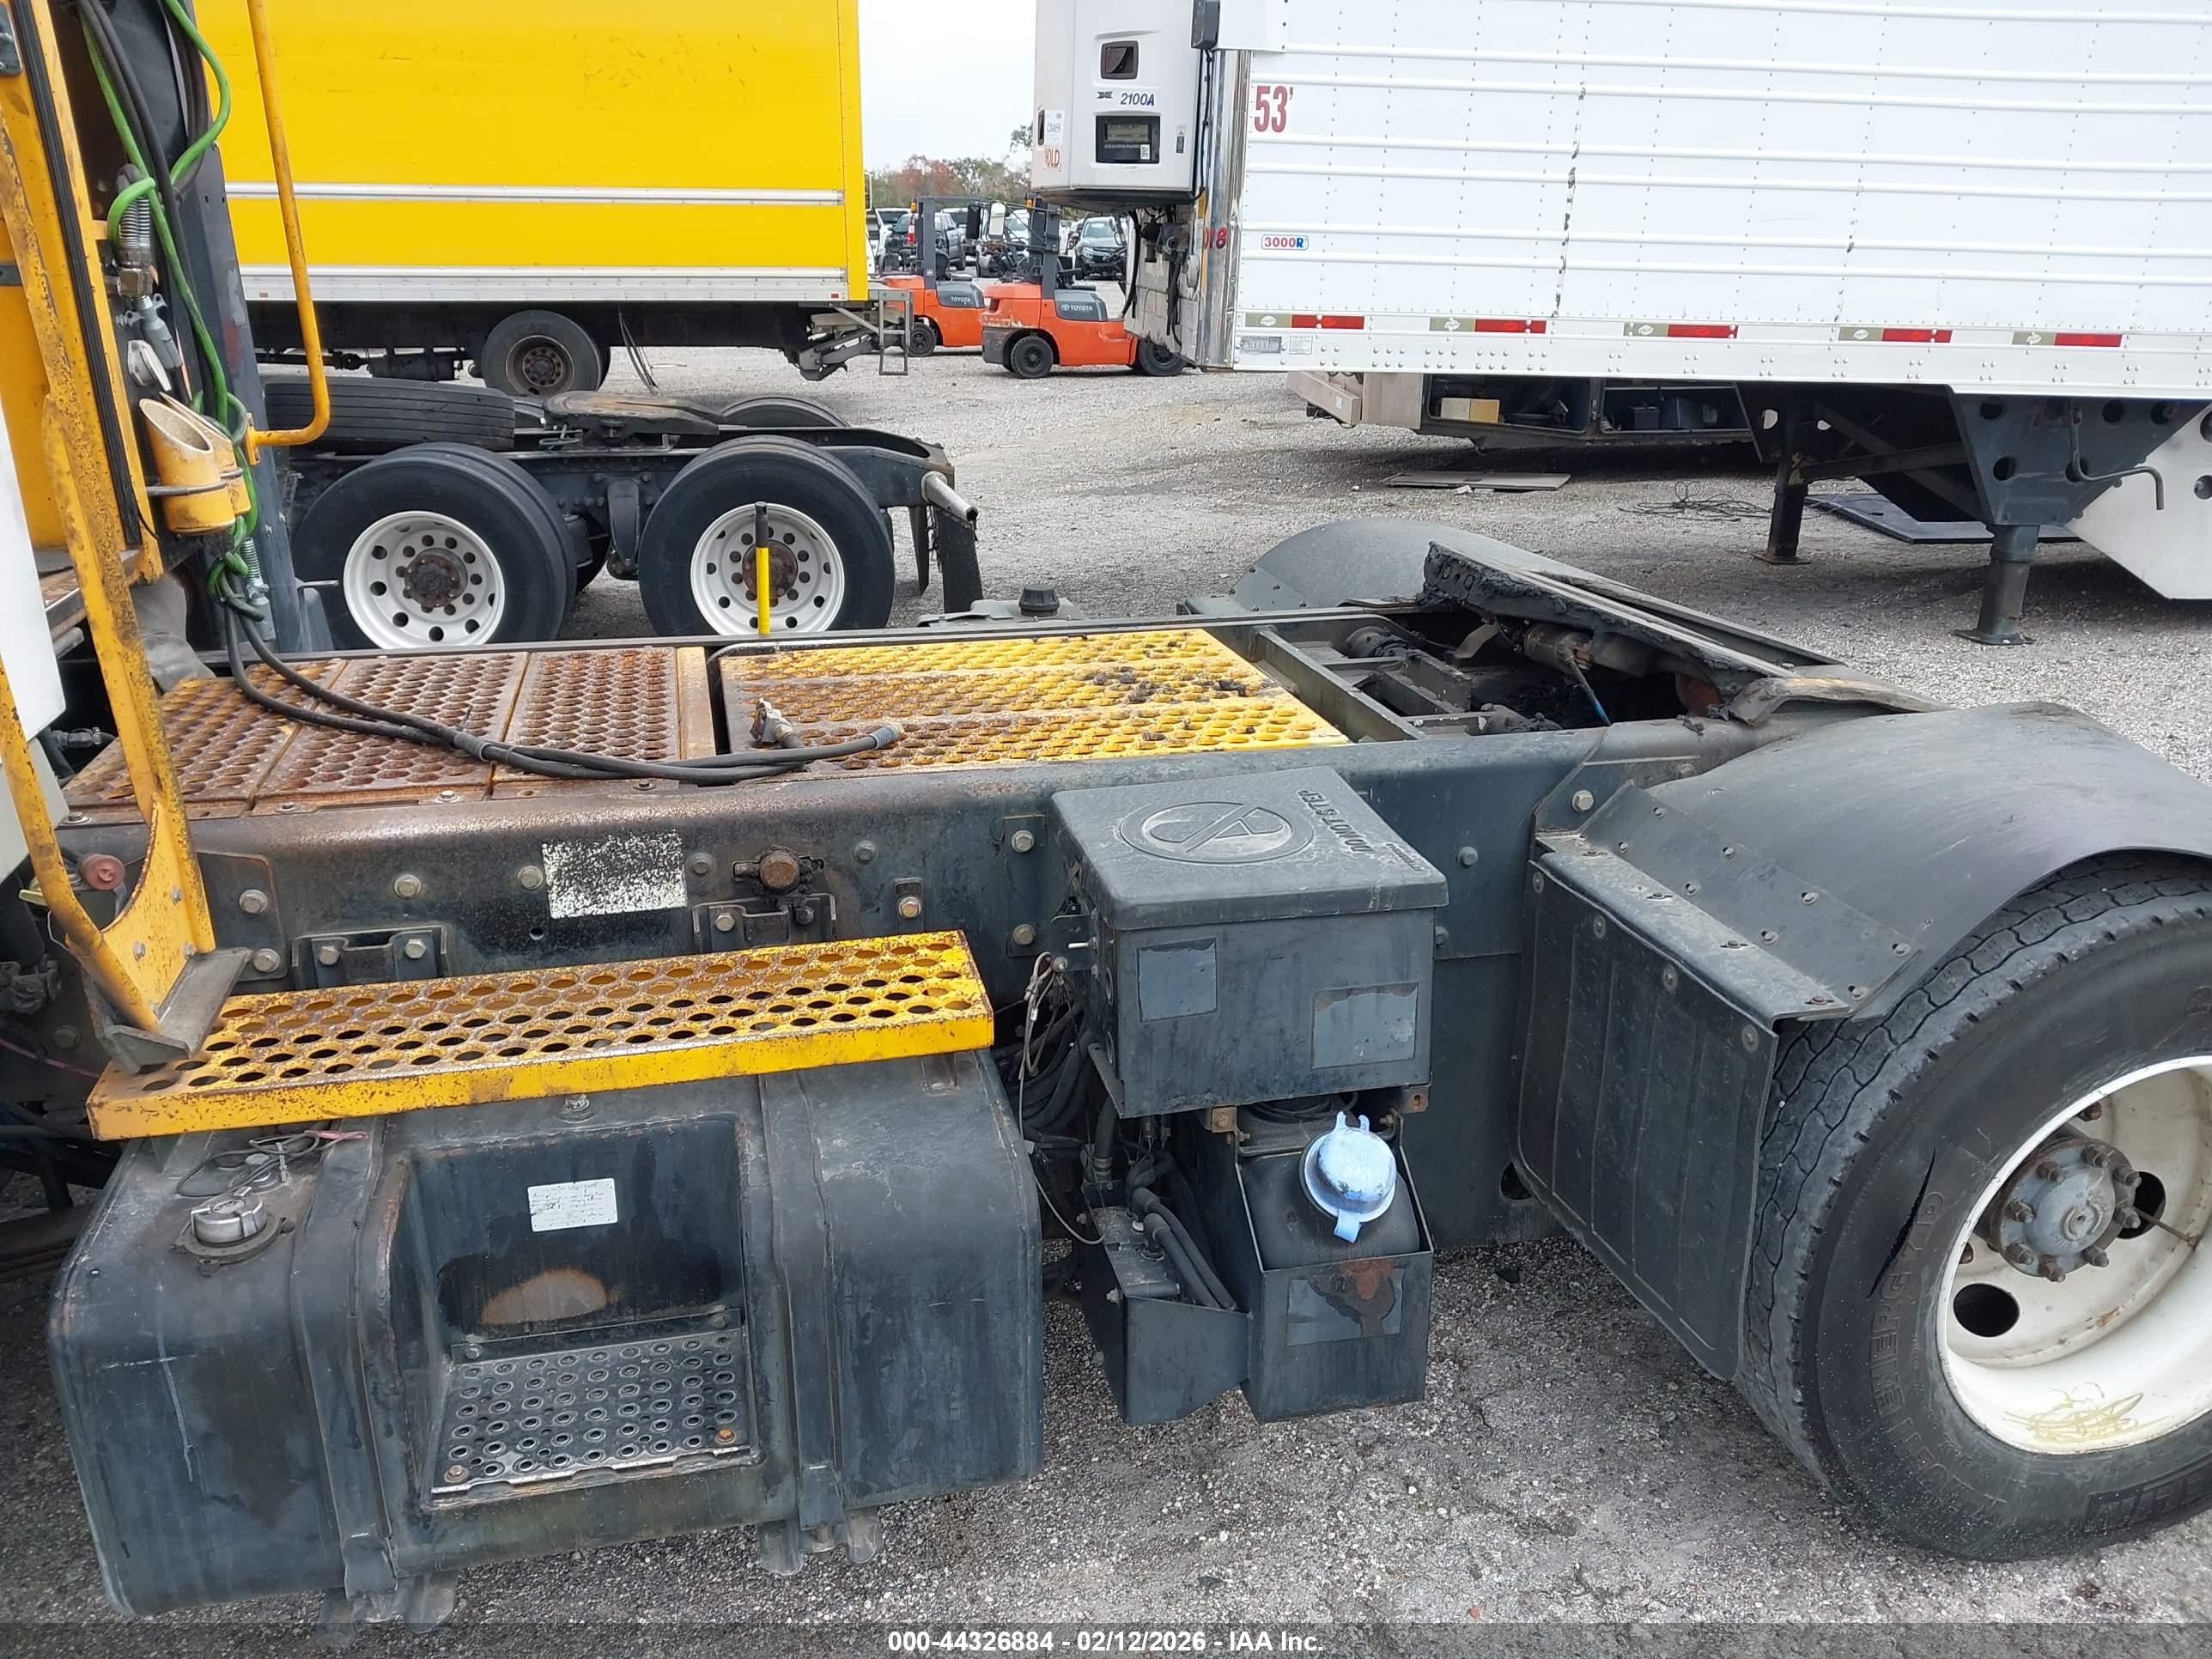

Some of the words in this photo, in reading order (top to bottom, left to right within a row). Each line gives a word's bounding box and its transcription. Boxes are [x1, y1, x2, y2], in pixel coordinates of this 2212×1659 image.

[1120, 92, 1155, 106] 2100A
[1264, 236, 1304, 248] 3000R
[1297, 789, 1339, 817] STEP
